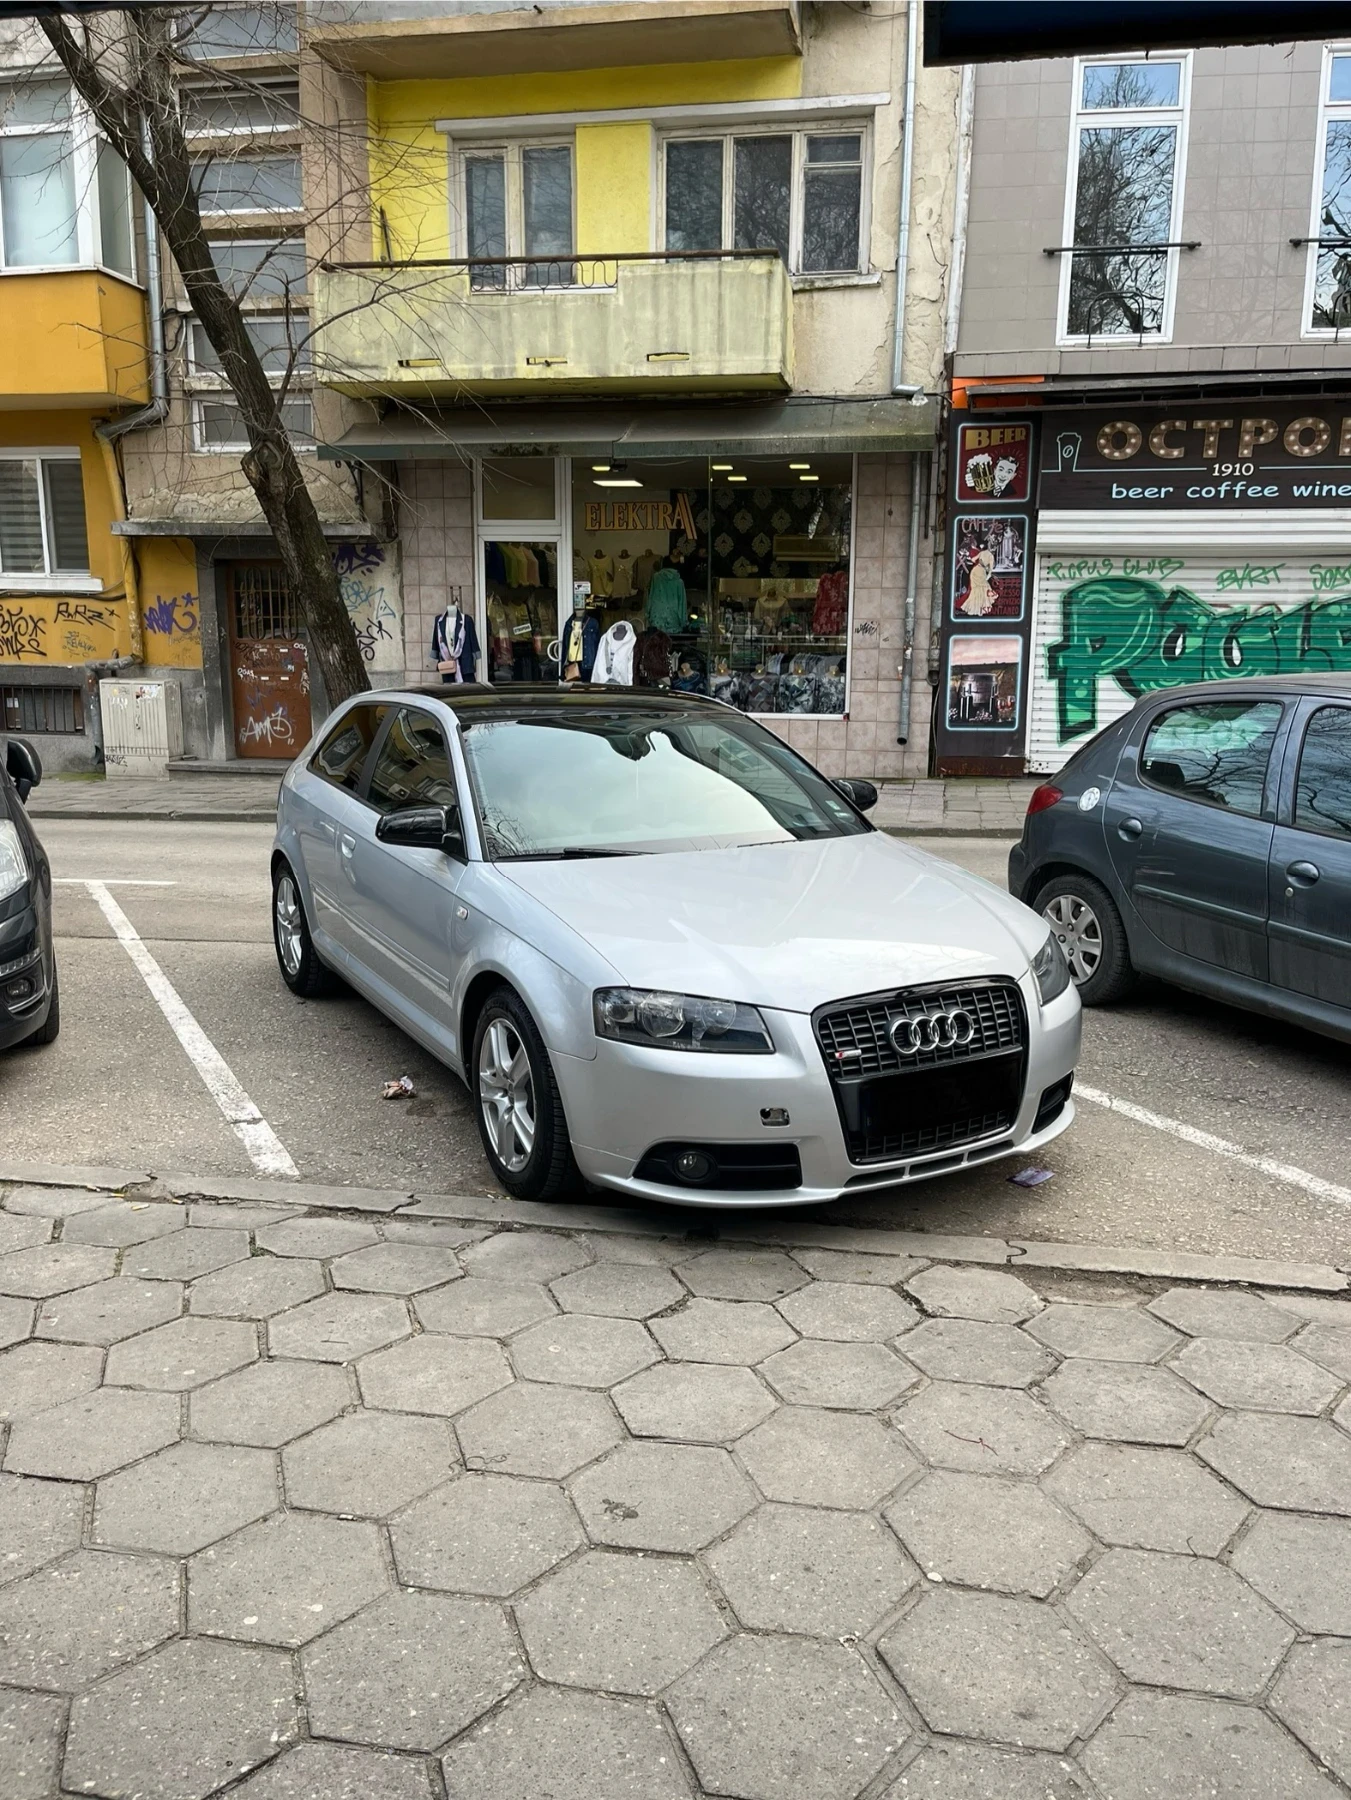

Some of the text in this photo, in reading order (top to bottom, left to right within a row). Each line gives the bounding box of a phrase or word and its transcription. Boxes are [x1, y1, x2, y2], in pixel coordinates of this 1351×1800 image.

[965, 427, 1026, 450] BEER
[1212, 463, 1254, 476] 1910
[1111, 481, 1351, 499] beer coffee wine
[585, 493, 697, 540] ELEKTRA
